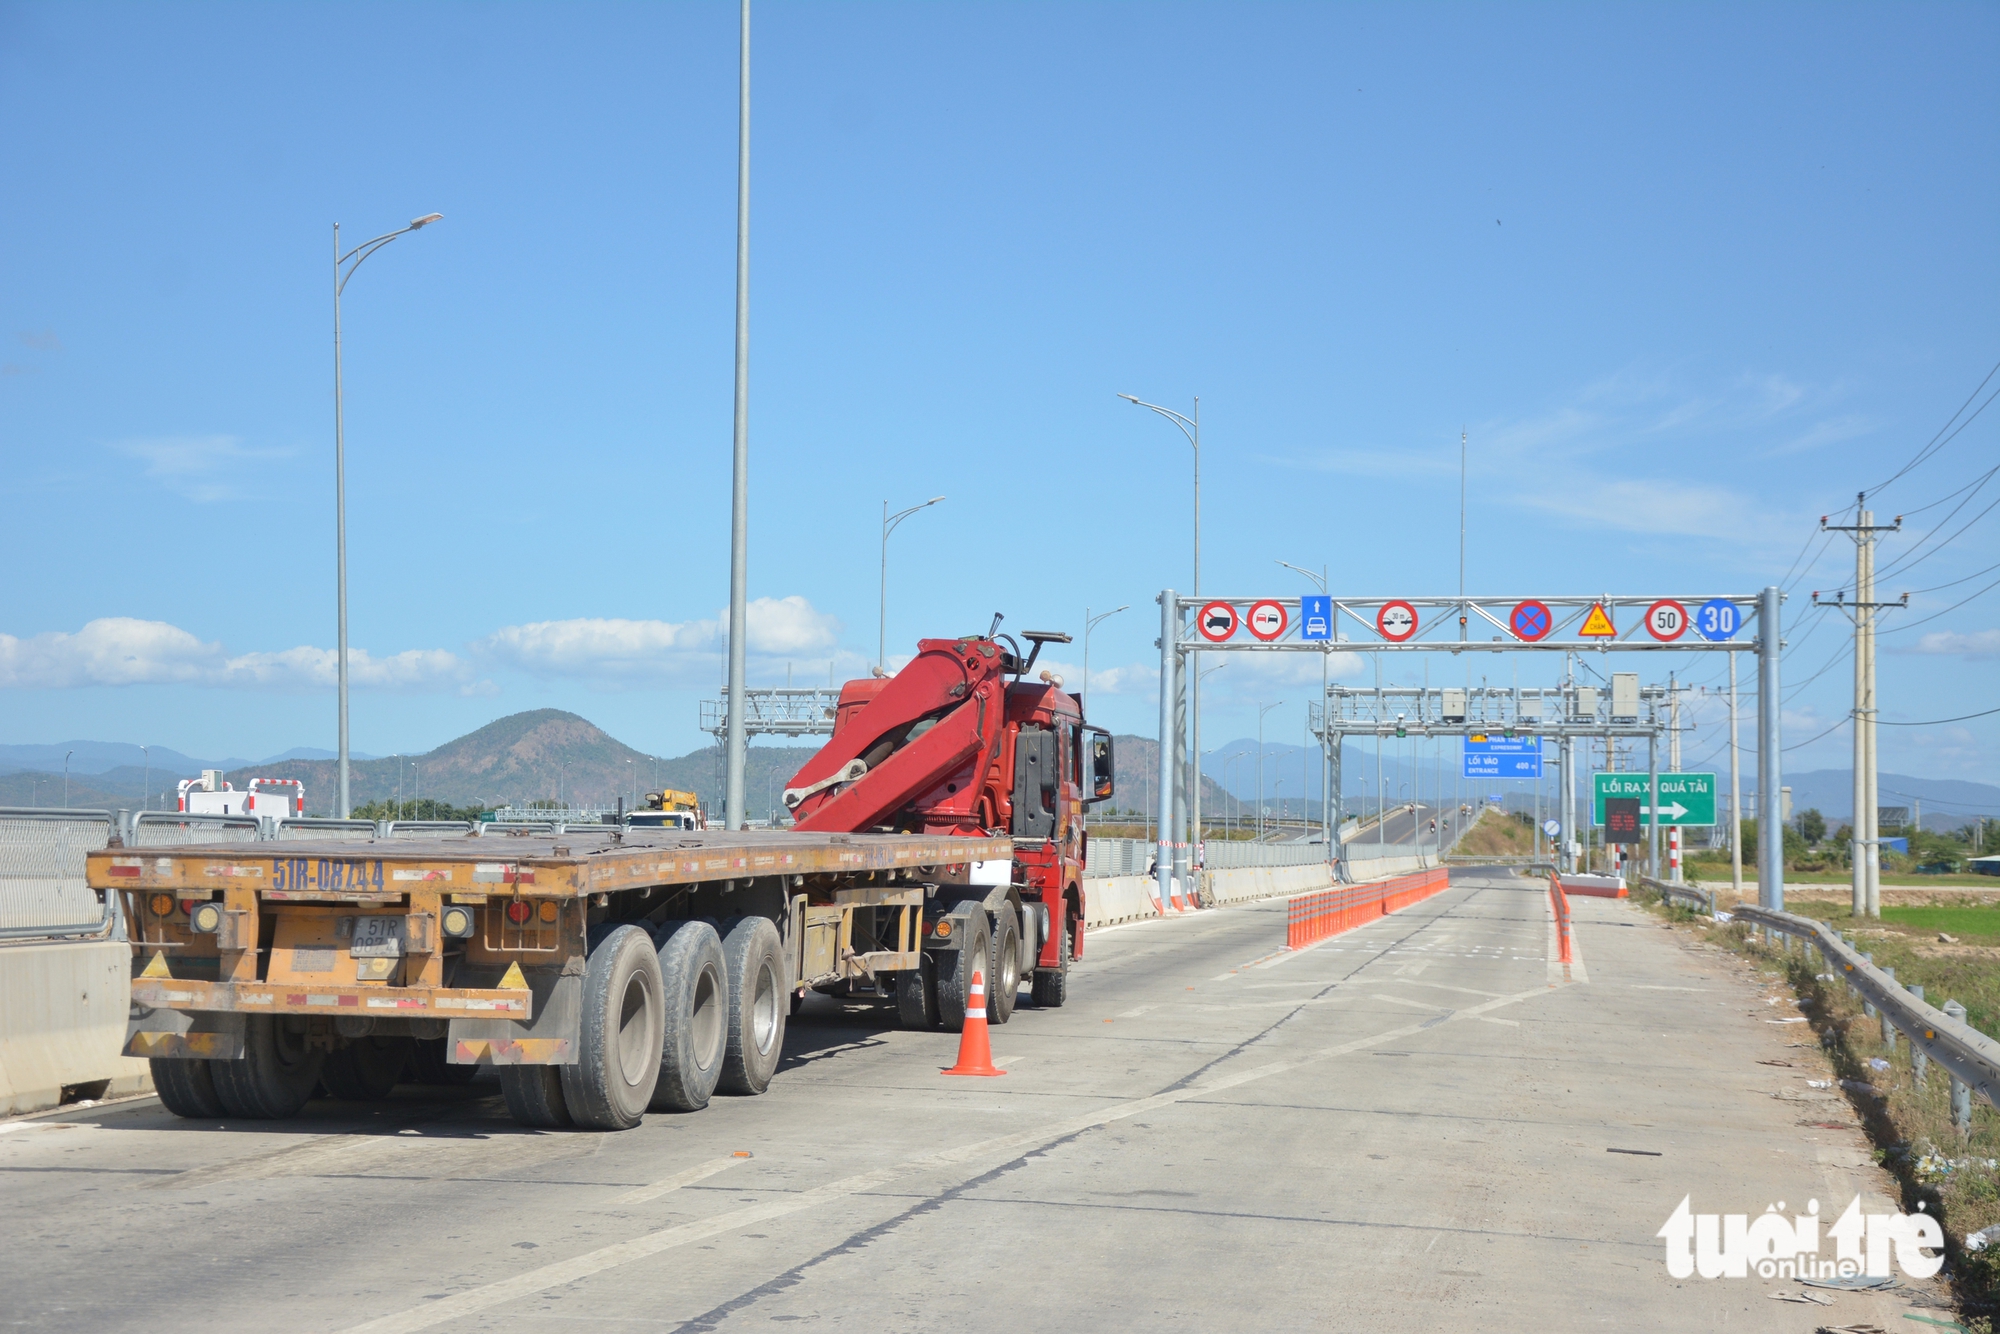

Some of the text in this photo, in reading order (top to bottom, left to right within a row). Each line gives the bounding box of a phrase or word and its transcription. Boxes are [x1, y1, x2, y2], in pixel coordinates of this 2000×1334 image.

[1392, 612, 1398, 620] 30
[1657, 611, 1676, 629] 50
[1705, 606, 1733, 633] 30
[1468, 754, 1499, 765] LỐI VÀO
[1602, 778, 1621, 793] LỐI
[1624, 782, 1641, 793] RA
[1660, 780, 1686, 794] QUÁ
[1688, 779, 1708, 793] TẢI
[368, 919, 398, 936] 51R
